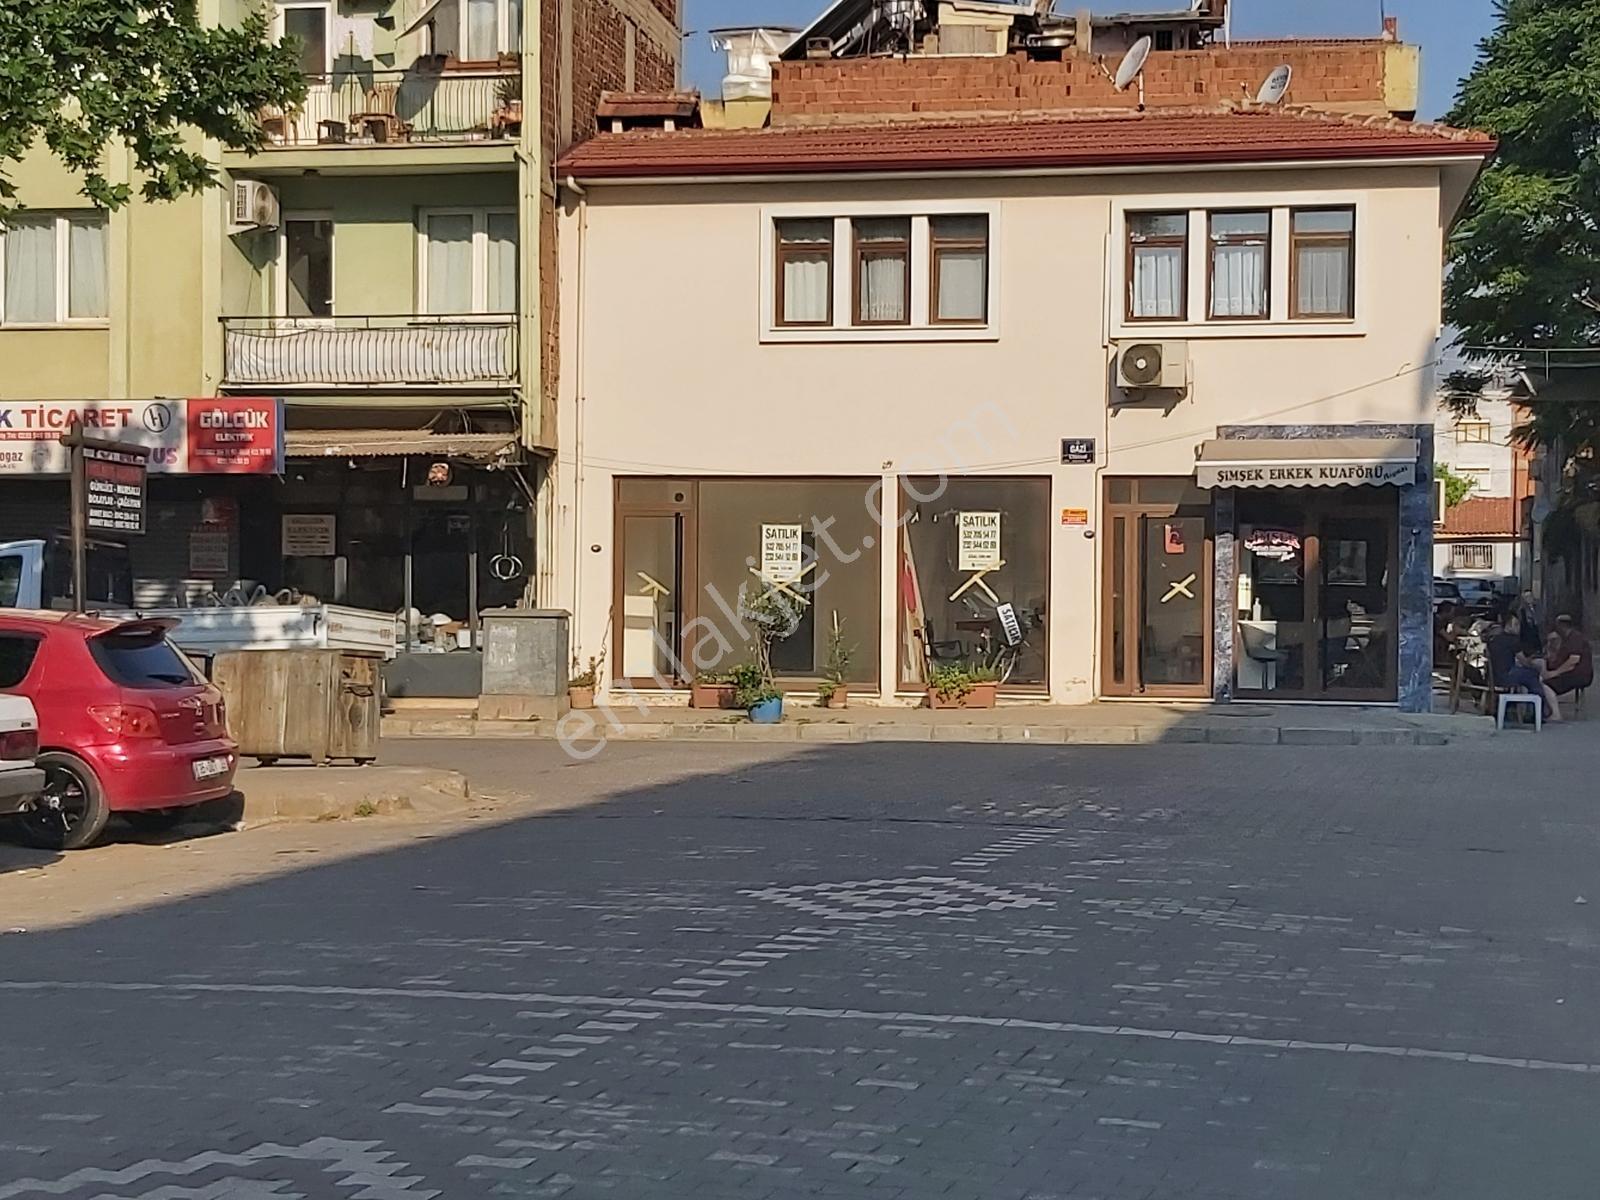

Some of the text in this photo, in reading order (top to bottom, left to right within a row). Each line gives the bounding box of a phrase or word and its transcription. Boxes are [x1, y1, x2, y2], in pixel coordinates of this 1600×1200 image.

[21, 404, 133, 428] TİCARET
[200, 408, 268, 428] GÖLCÜK
[1269, 467, 1314, 480] ERKEK
[1319, 464, 1383, 479] KUAFÖRÜ
[765, 528, 798, 539] SATILIK
